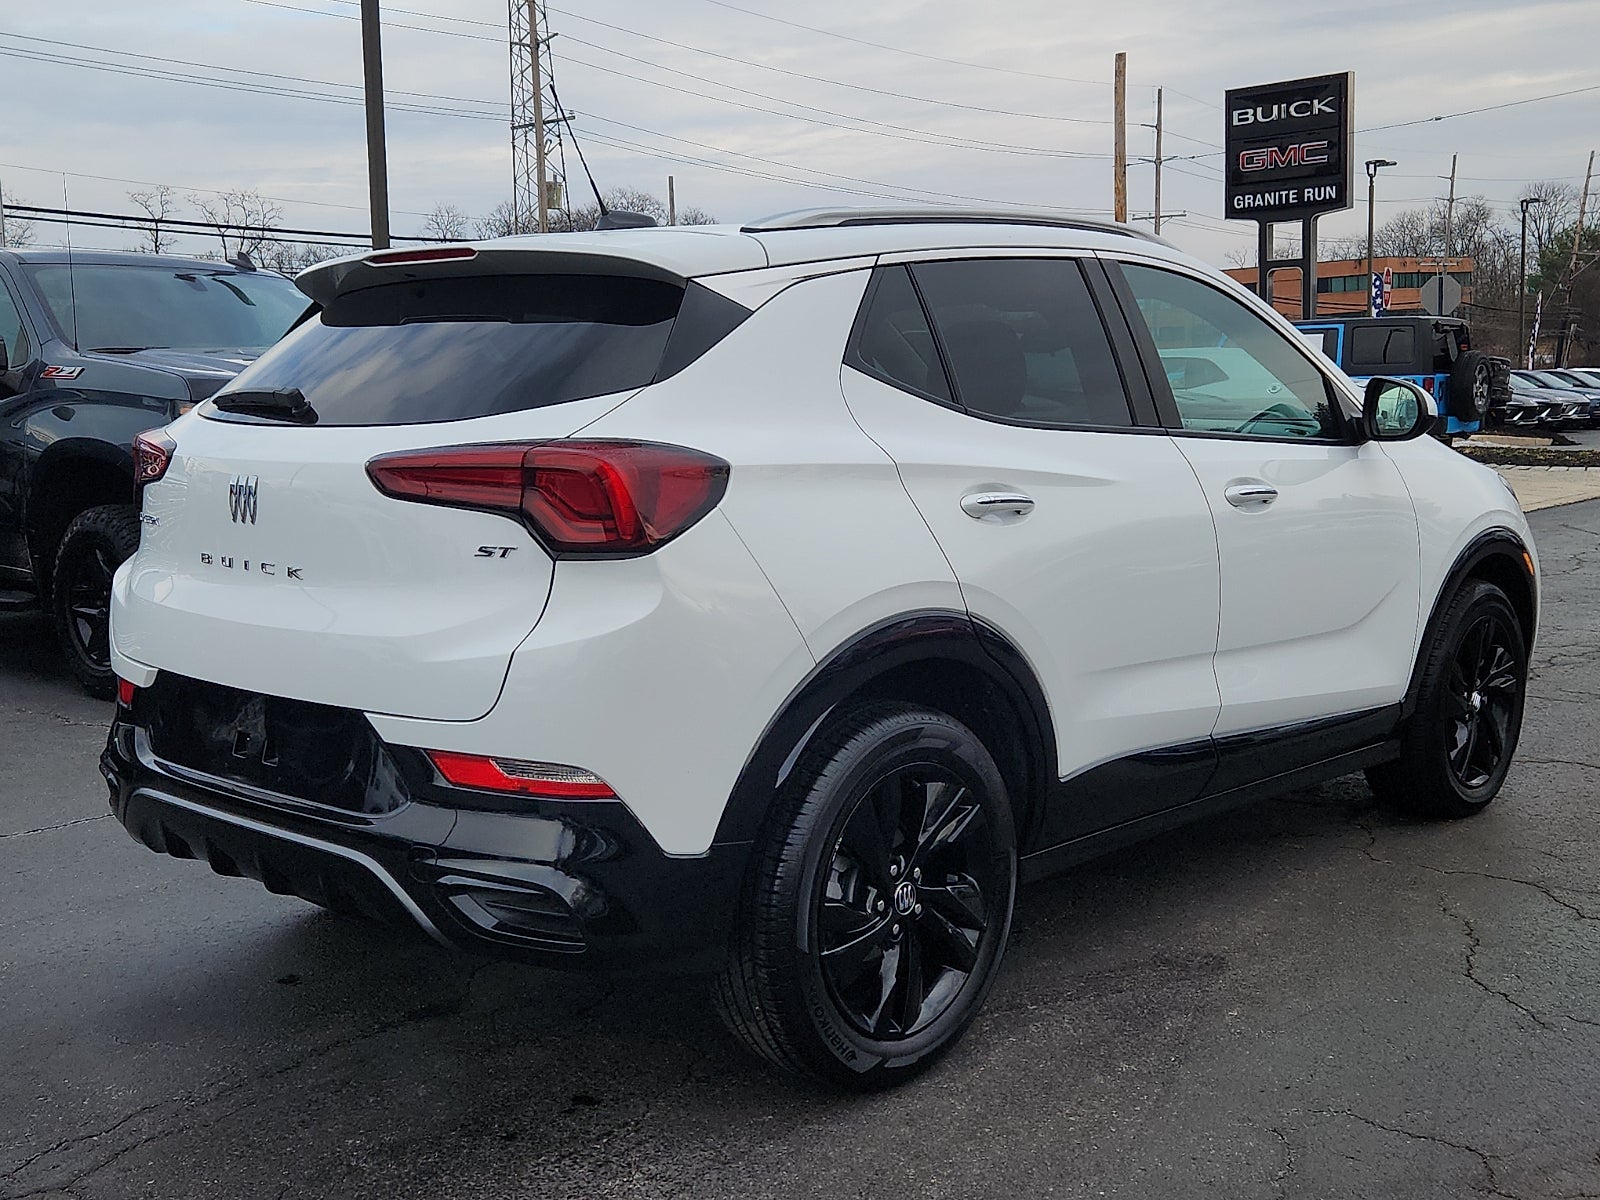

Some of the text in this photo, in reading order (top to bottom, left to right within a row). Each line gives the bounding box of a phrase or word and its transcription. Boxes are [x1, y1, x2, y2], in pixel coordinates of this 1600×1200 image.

[1232, 97, 1336, 126] BUICK
[1239, 141, 1328, 171] GMC
[1234, 186, 1336, 209] GRANITE RUN
[40, 365, 85, 379] Z71
[474, 546, 518, 558] ST
[200, 553, 303, 580] BUICK
